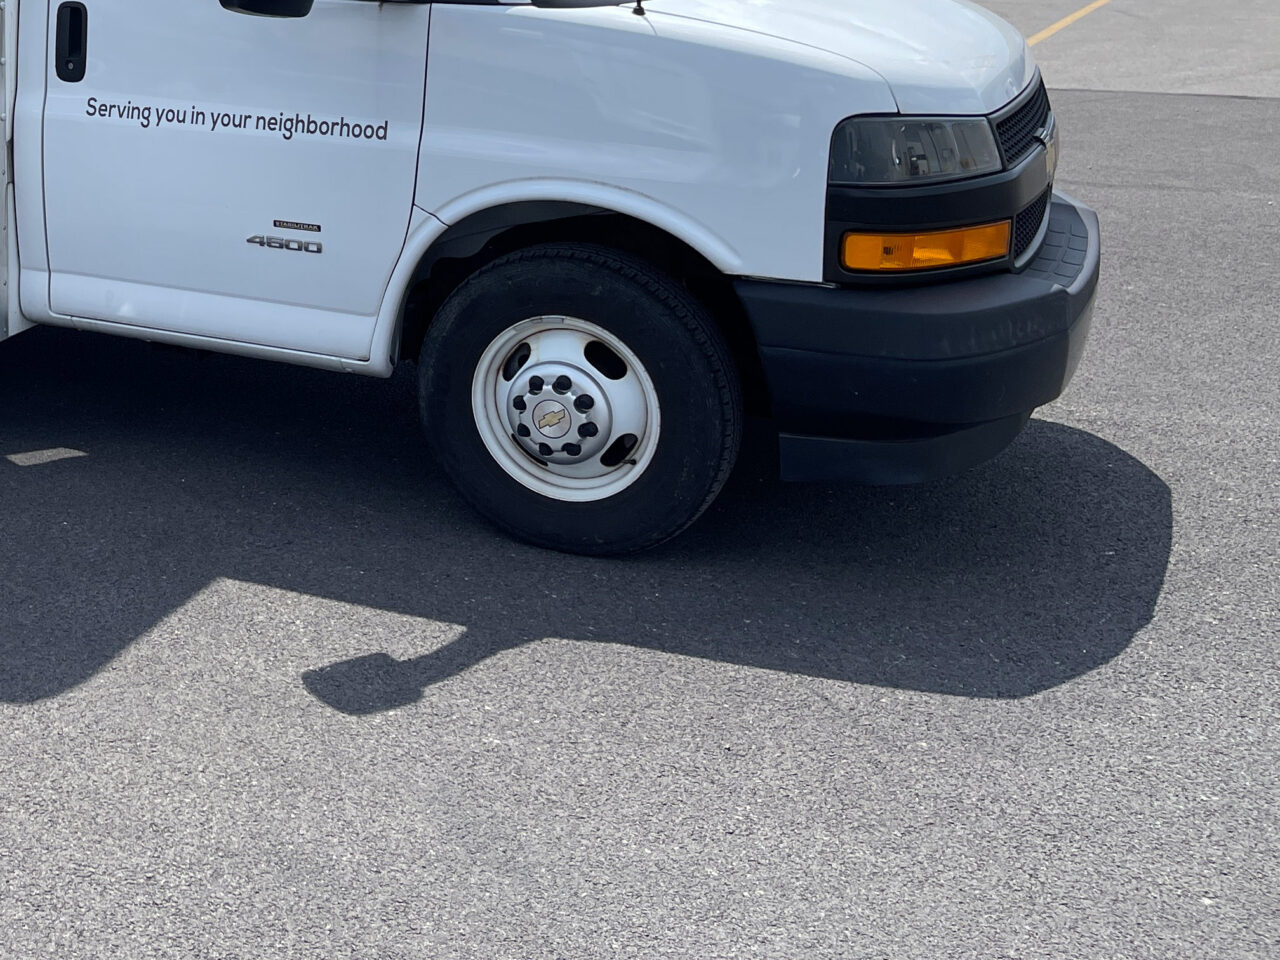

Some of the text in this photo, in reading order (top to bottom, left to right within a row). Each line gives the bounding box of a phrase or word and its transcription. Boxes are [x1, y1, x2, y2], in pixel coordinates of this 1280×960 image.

[86, 97, 388, 140] Serving you in your neighborhood
